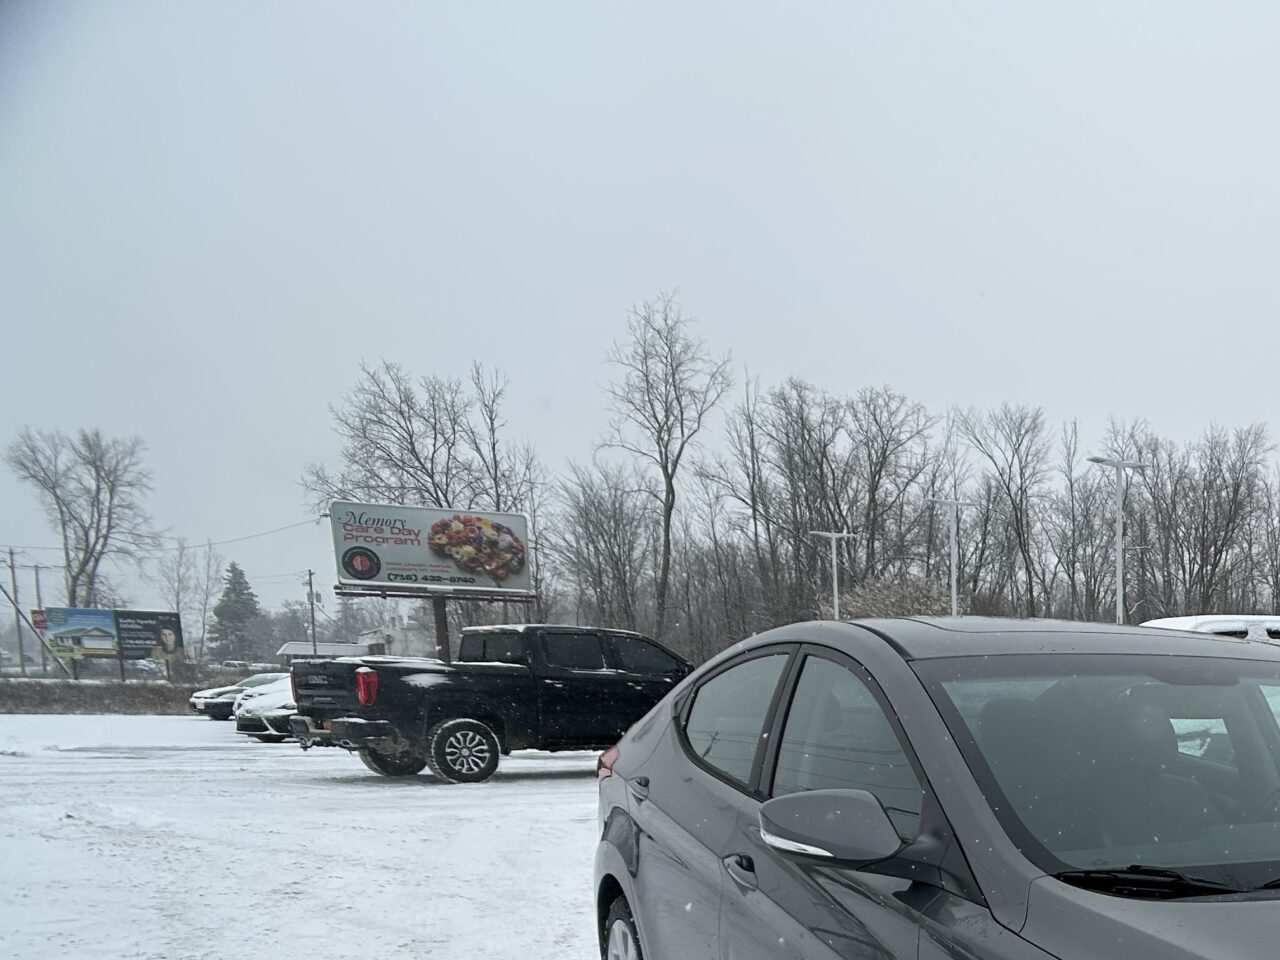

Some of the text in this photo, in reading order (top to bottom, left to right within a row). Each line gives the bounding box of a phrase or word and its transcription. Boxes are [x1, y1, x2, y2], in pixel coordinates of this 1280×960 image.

[338, 511, 408, 530] Memory
[342, 522, 421, 538] Care Day
[343, 532, 421, 546] Program
